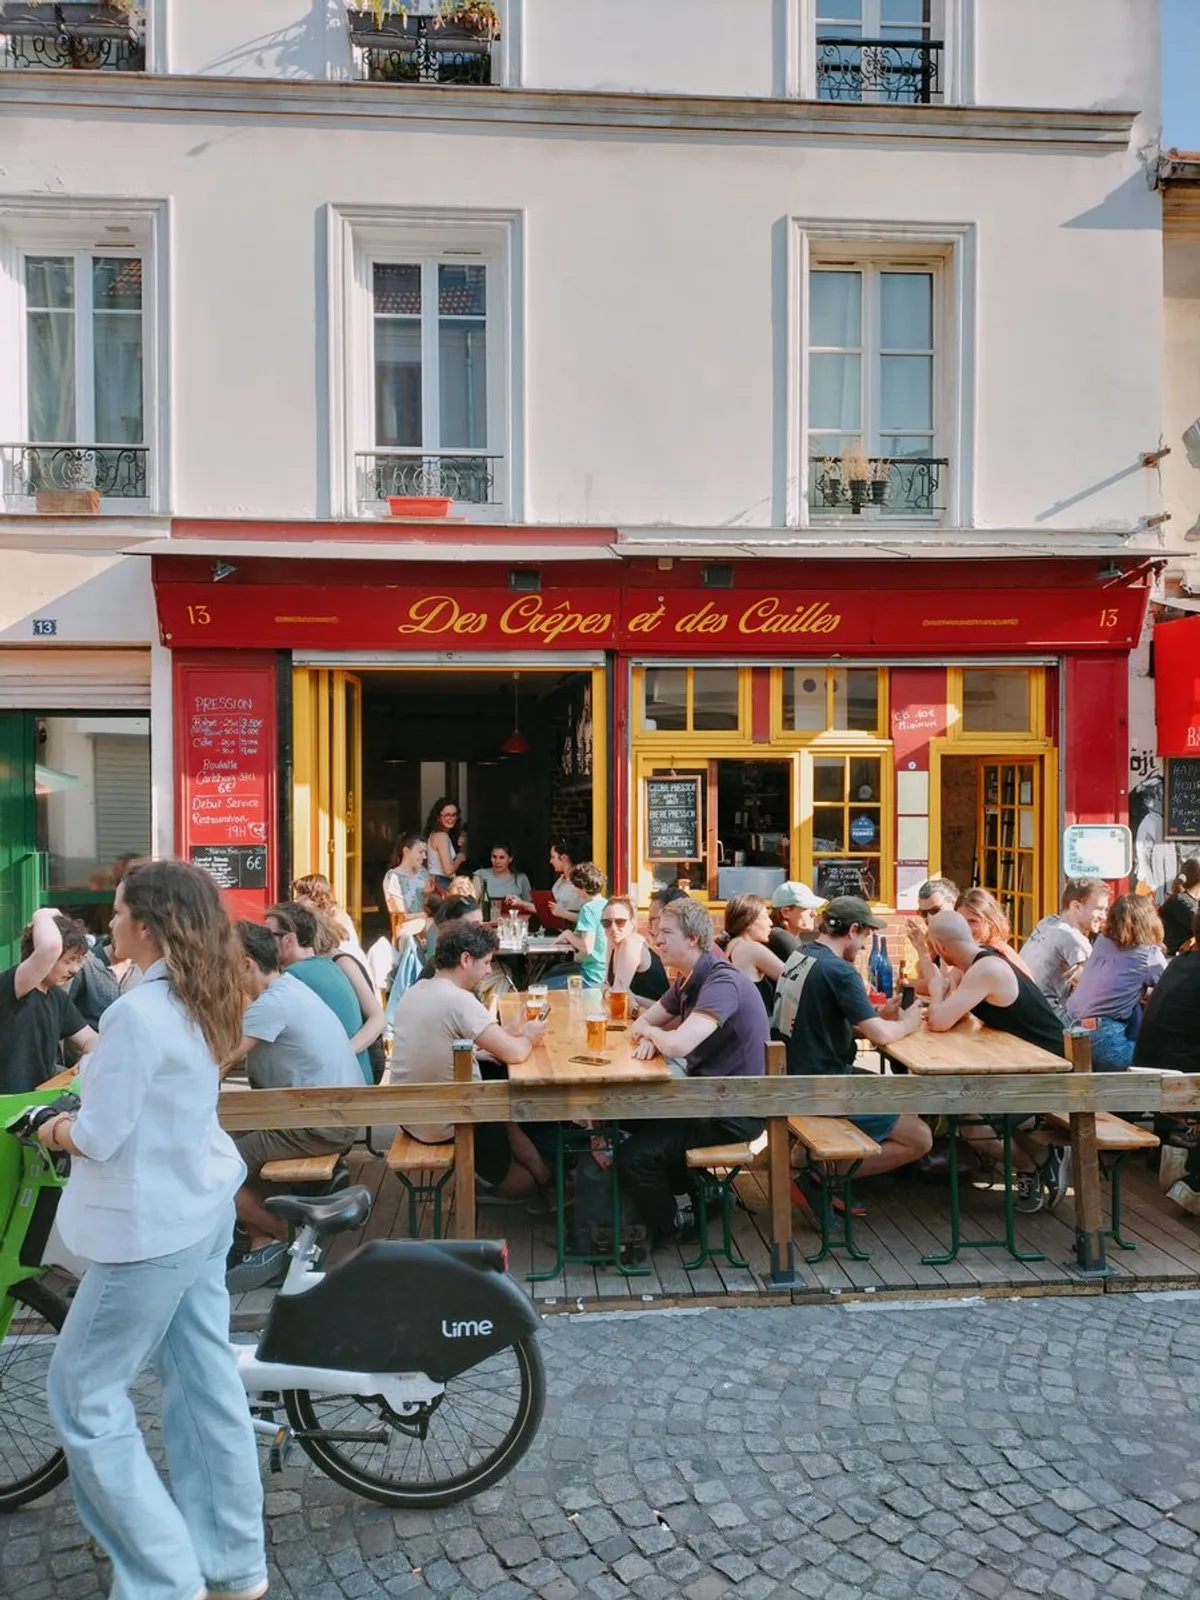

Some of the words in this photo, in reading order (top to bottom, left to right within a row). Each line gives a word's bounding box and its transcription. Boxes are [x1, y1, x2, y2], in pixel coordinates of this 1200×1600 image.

[186, 605, 211, 625] 13
[398, 595, 488, 634] Des
[500, 594, 612, 644] Crêpes
[628, 603, 667, 632] et
[675, 601, 729, 633] des
[738, 597, 841, 634] Cailles
[1099, 608, 1119, 627] 13
[37, 621, 53, 634] 13
[194, 696, 252, 712] PRESSION
[246, 856, 262, 870] 6€
[441, 1319, 494, 1338] Lime
